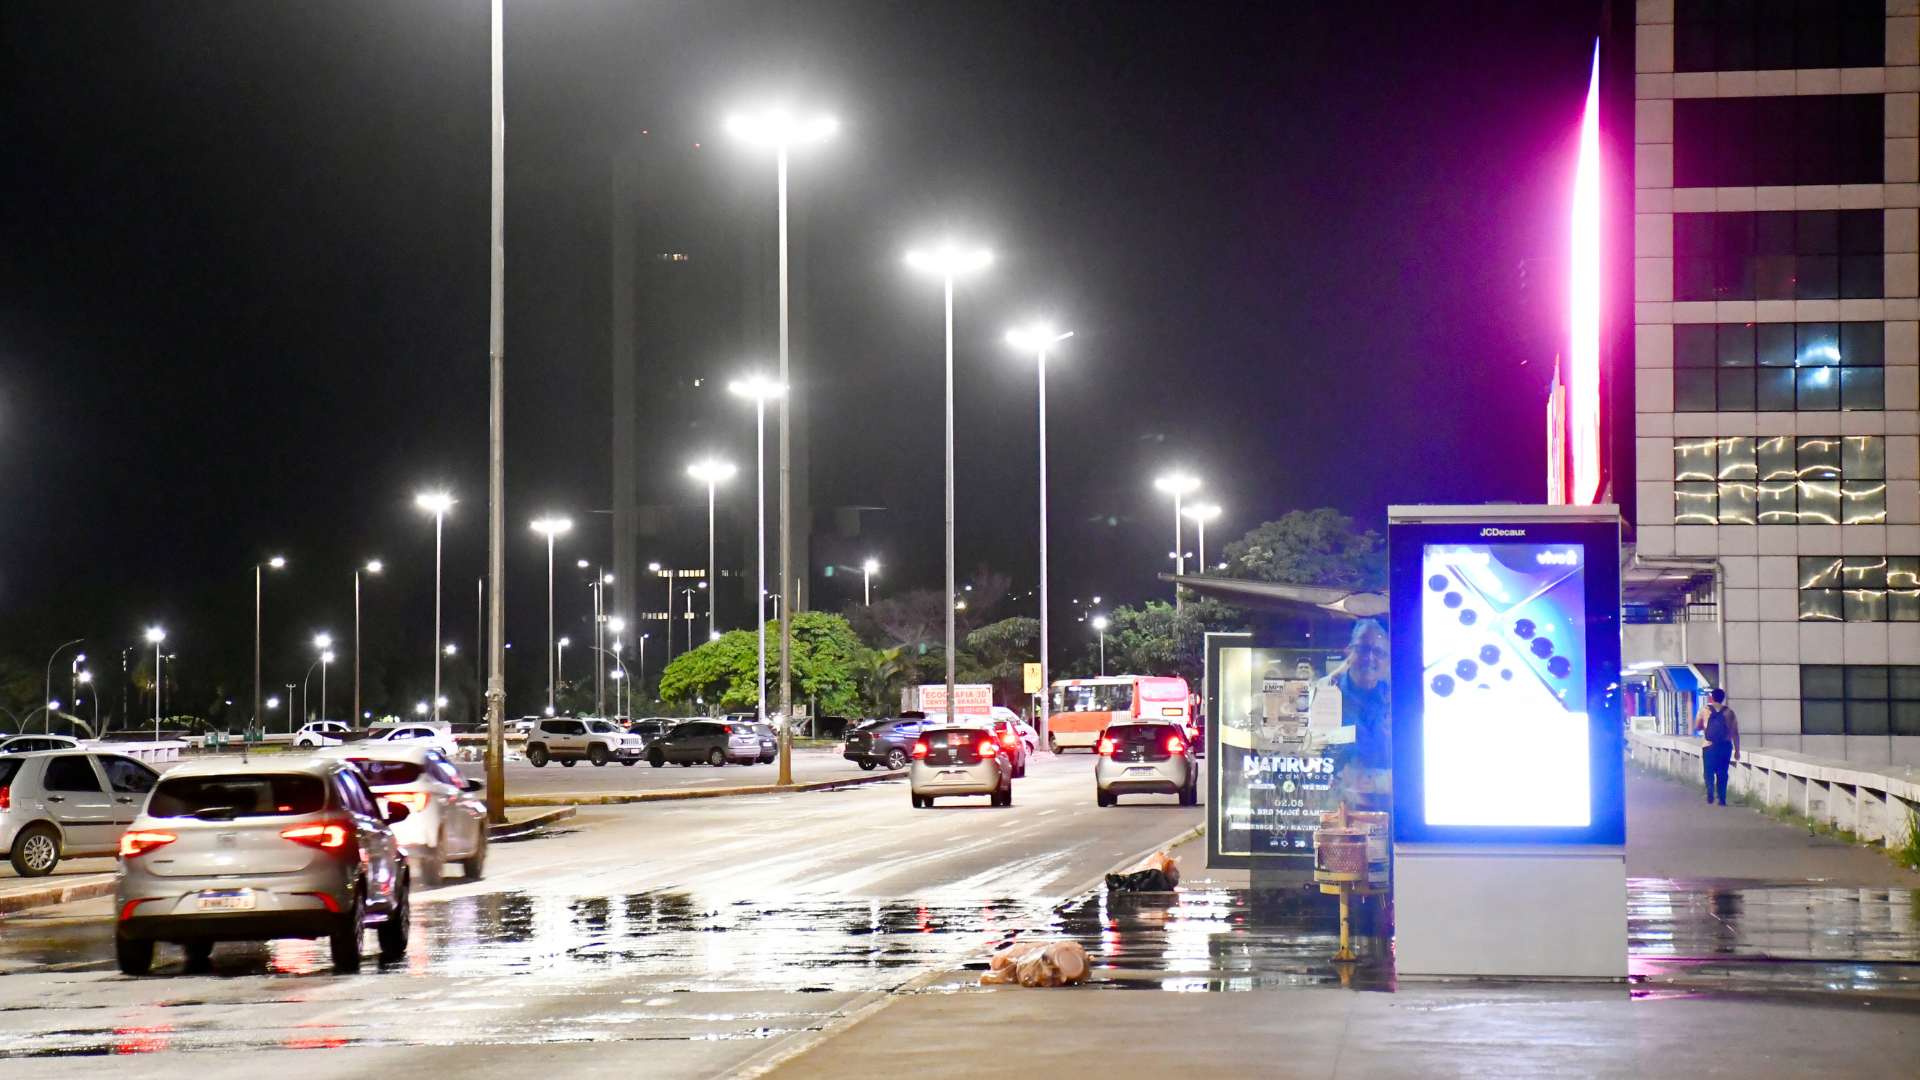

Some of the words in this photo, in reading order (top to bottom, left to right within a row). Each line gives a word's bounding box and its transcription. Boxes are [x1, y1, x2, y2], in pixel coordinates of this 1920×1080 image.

[1480, 527, 1526, 537] JCDecaux
[1243, 755, 1335, 774] NATIRUTS
[1274, 799, 1304, 807] 02.08
